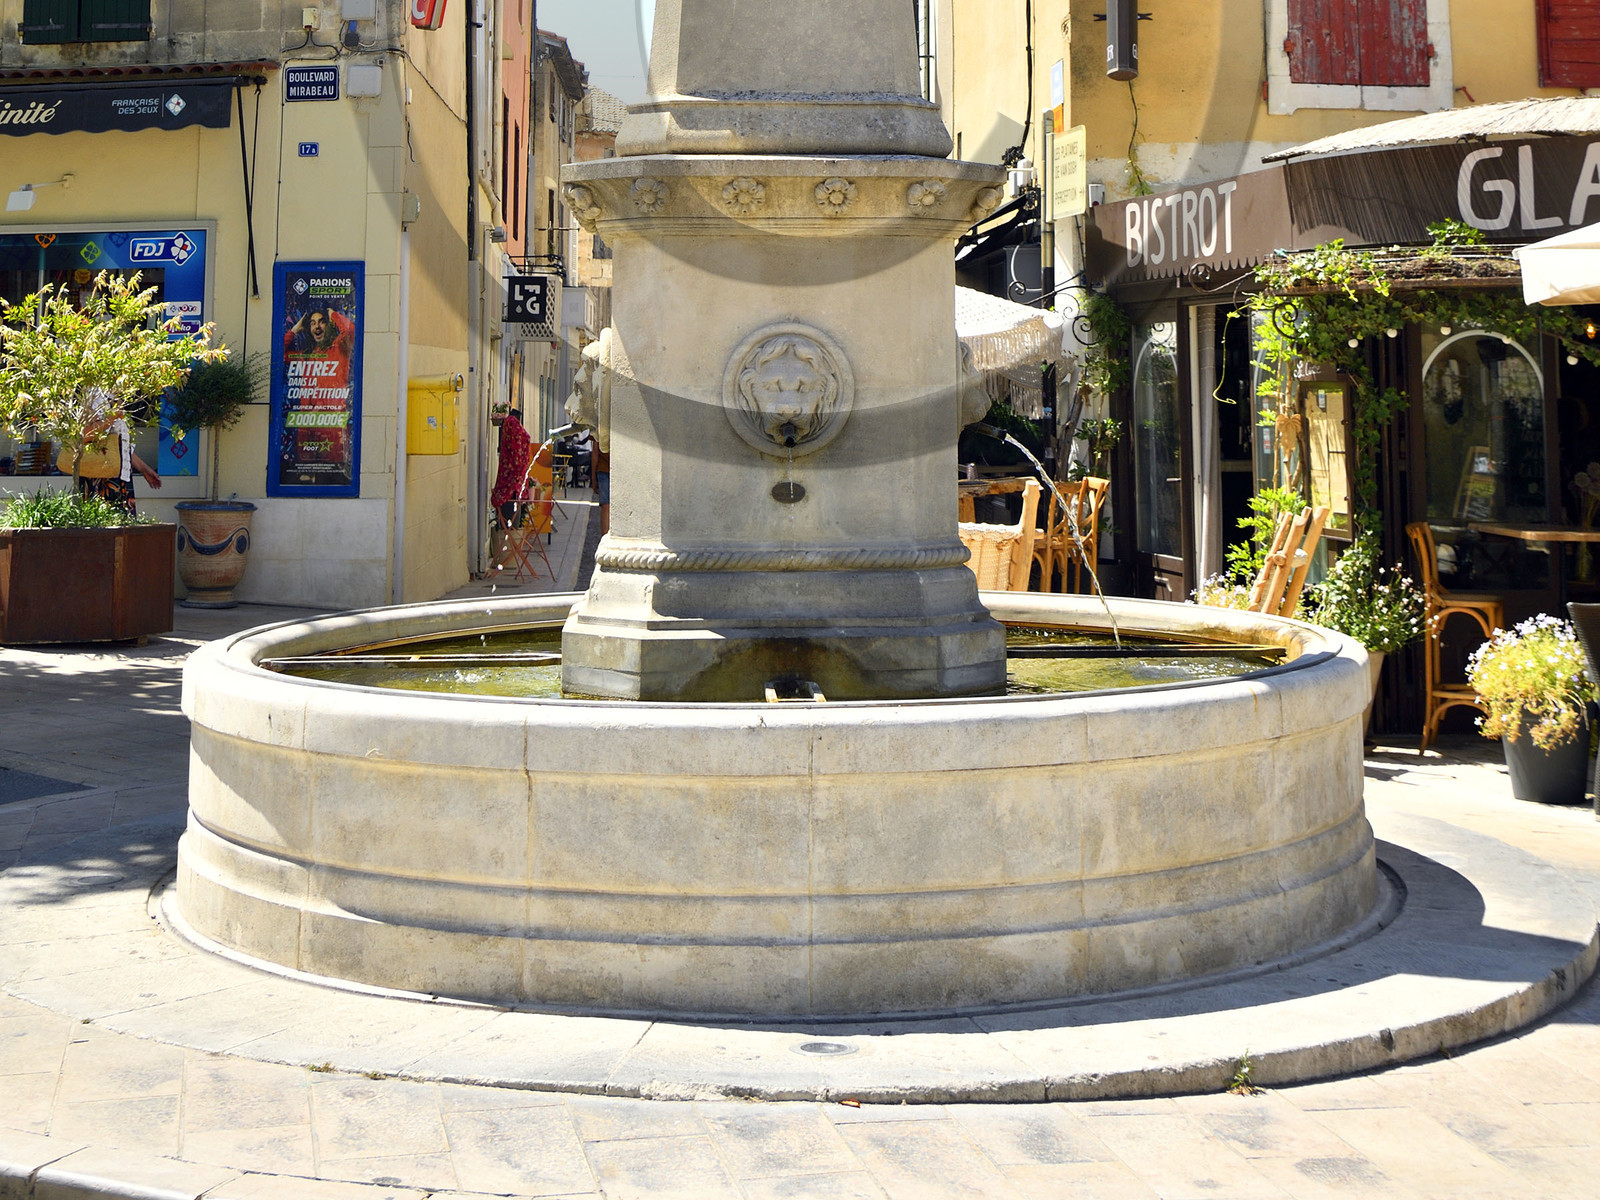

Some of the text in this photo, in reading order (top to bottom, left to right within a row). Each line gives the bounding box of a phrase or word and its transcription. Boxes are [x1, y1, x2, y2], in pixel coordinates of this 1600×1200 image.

[289, 72, 334, 83] BOULEVARD
[289, 86, 334, 96] MIRABEAU
[0, 100, 62, 125] inité
[136, 106, 158, 114] JEUX
[1125, 181, 1237, 268] BISTROT
[134, 242, 165, 257] FDJ
[288, 361, 339, 376] ENTREZ
[288, 378, 317, 386] DANS LA
